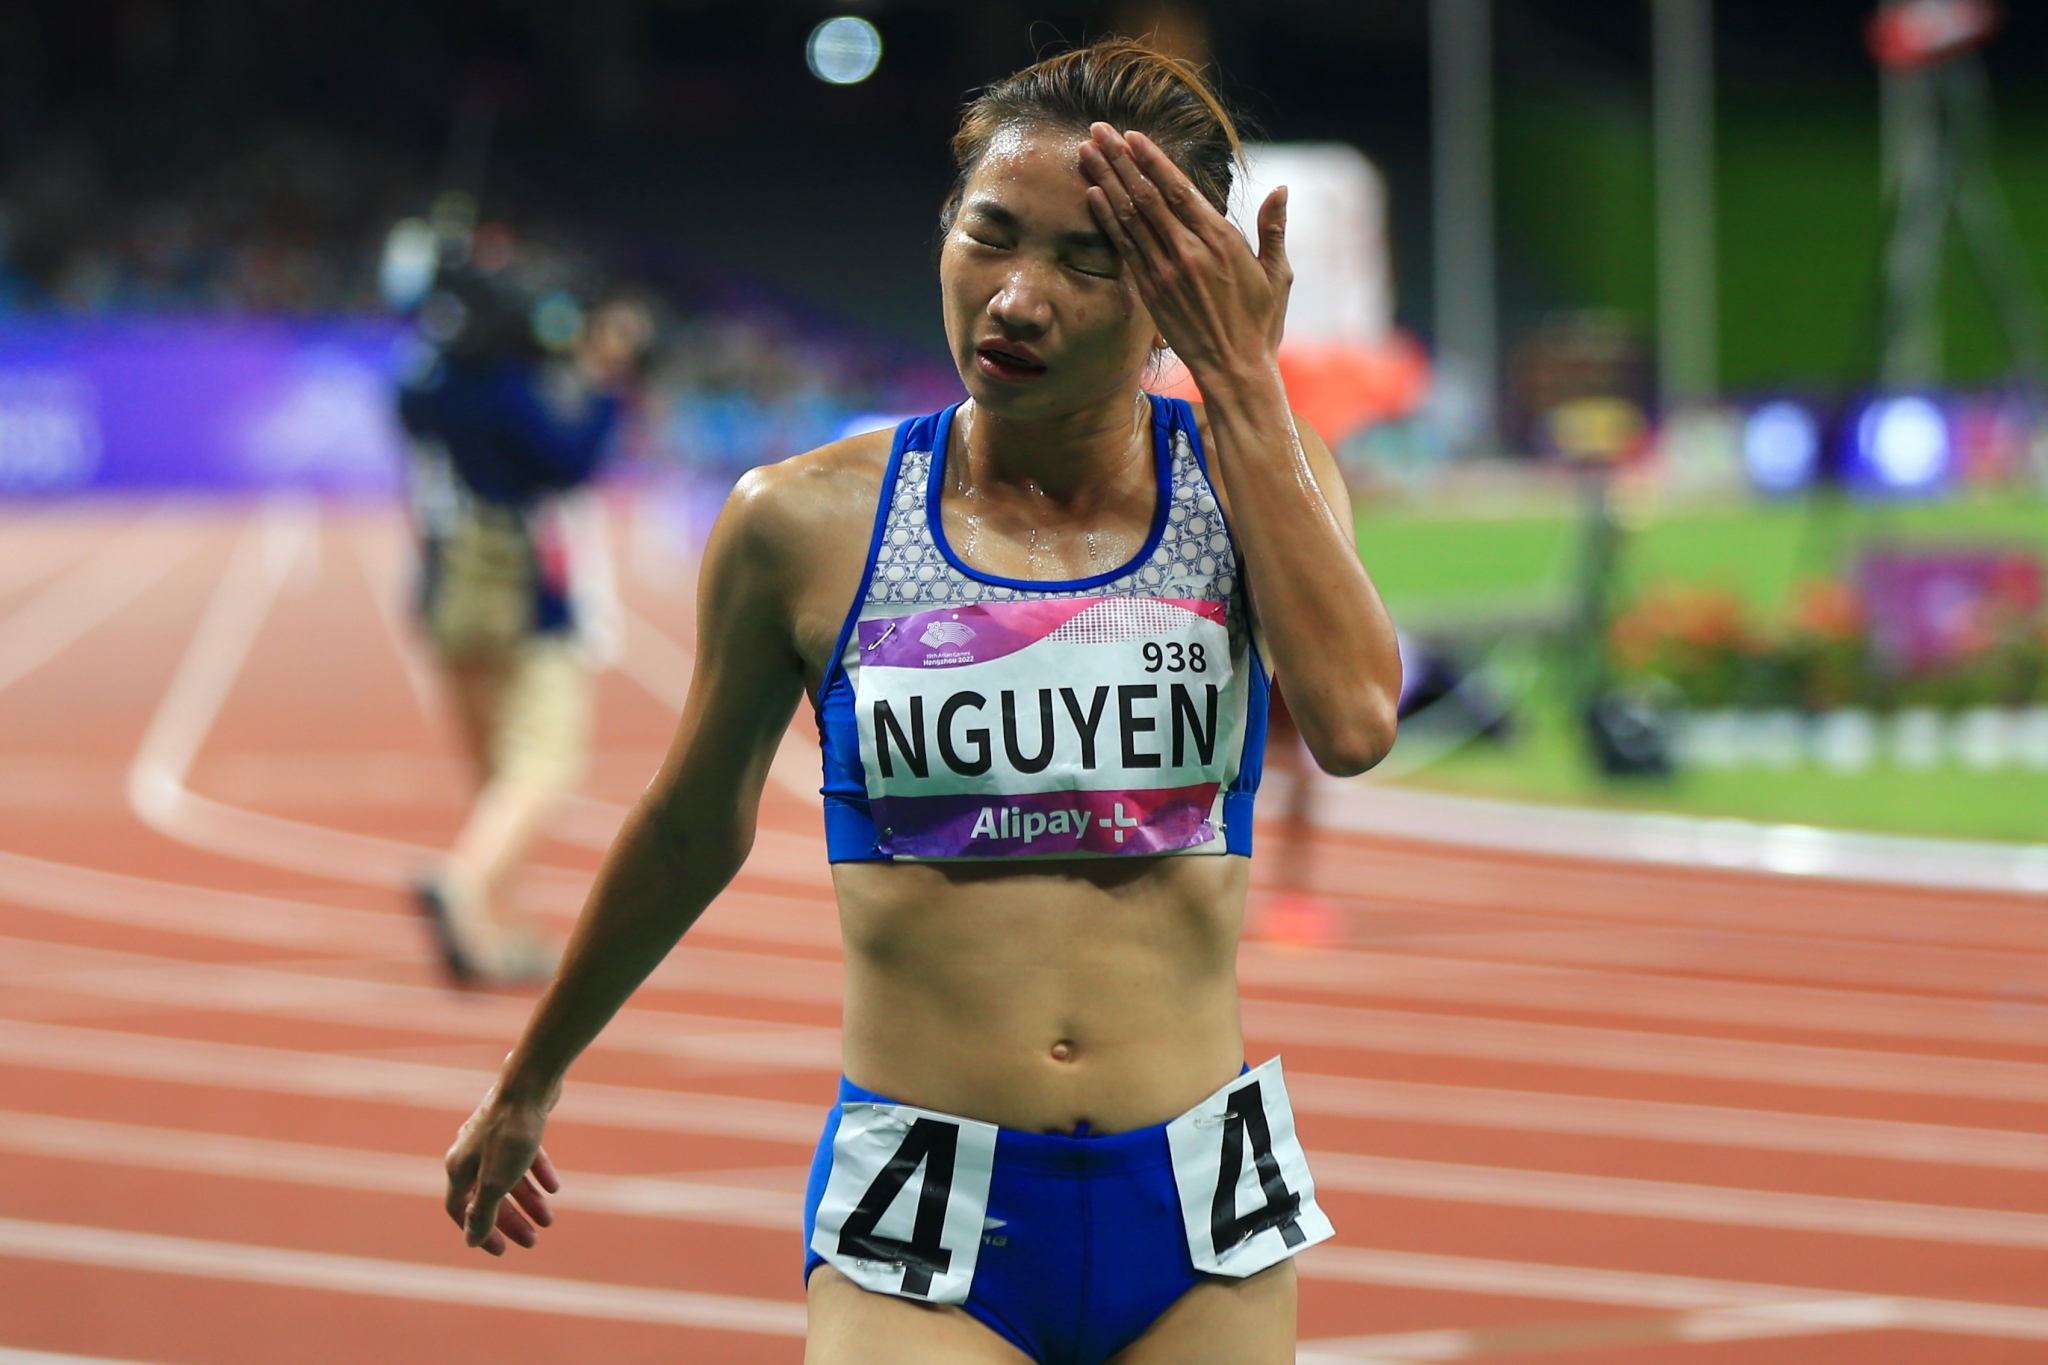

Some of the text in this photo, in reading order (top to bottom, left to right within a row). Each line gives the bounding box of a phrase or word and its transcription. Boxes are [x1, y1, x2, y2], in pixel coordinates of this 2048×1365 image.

[923, 655, 974, 666] Hangzhou 2022
[1143, 641, 1207, 674] 938
[873, 683, 1219, 779] NGUYEN
[837, 1117, 960, 1297] 4
[1210, 1080, 1307, 1256] 4
